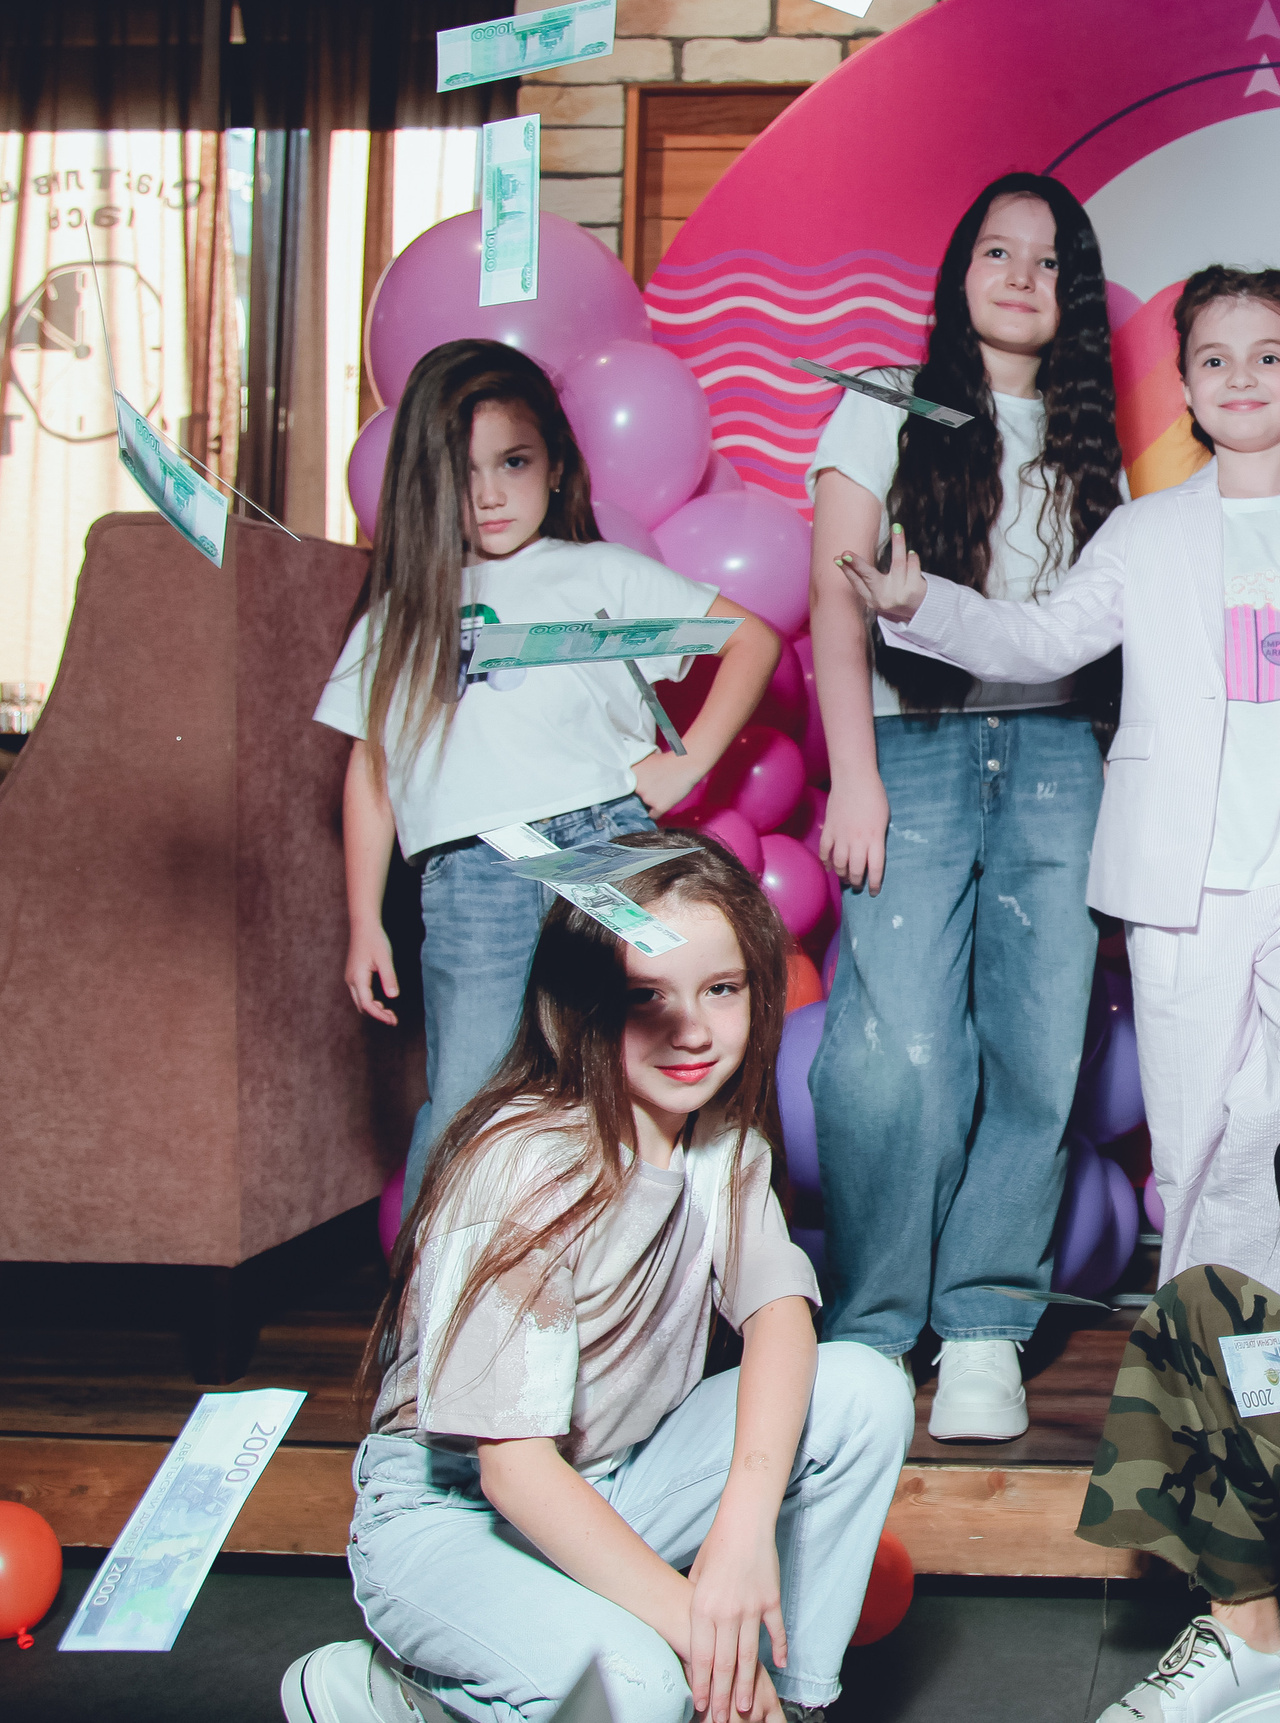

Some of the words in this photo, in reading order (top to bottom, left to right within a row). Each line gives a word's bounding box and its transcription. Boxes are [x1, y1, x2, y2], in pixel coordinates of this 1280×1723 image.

[470, 20, 514, 43] 1000
[484, 227, 497, 272] 1000
[135, 416, 159, 456] 1000
[528, 623, 592, 633] 1000
[1240, 1388, 1275, 1409] 2000
[172, 1442, 193, 1462] ДВЕ
[222, 1421, 280, 1482] 2000
[145, 1465, 181, 1509] ТЫСЯЧИ
[90, 1563, 128, 1605] 2000
